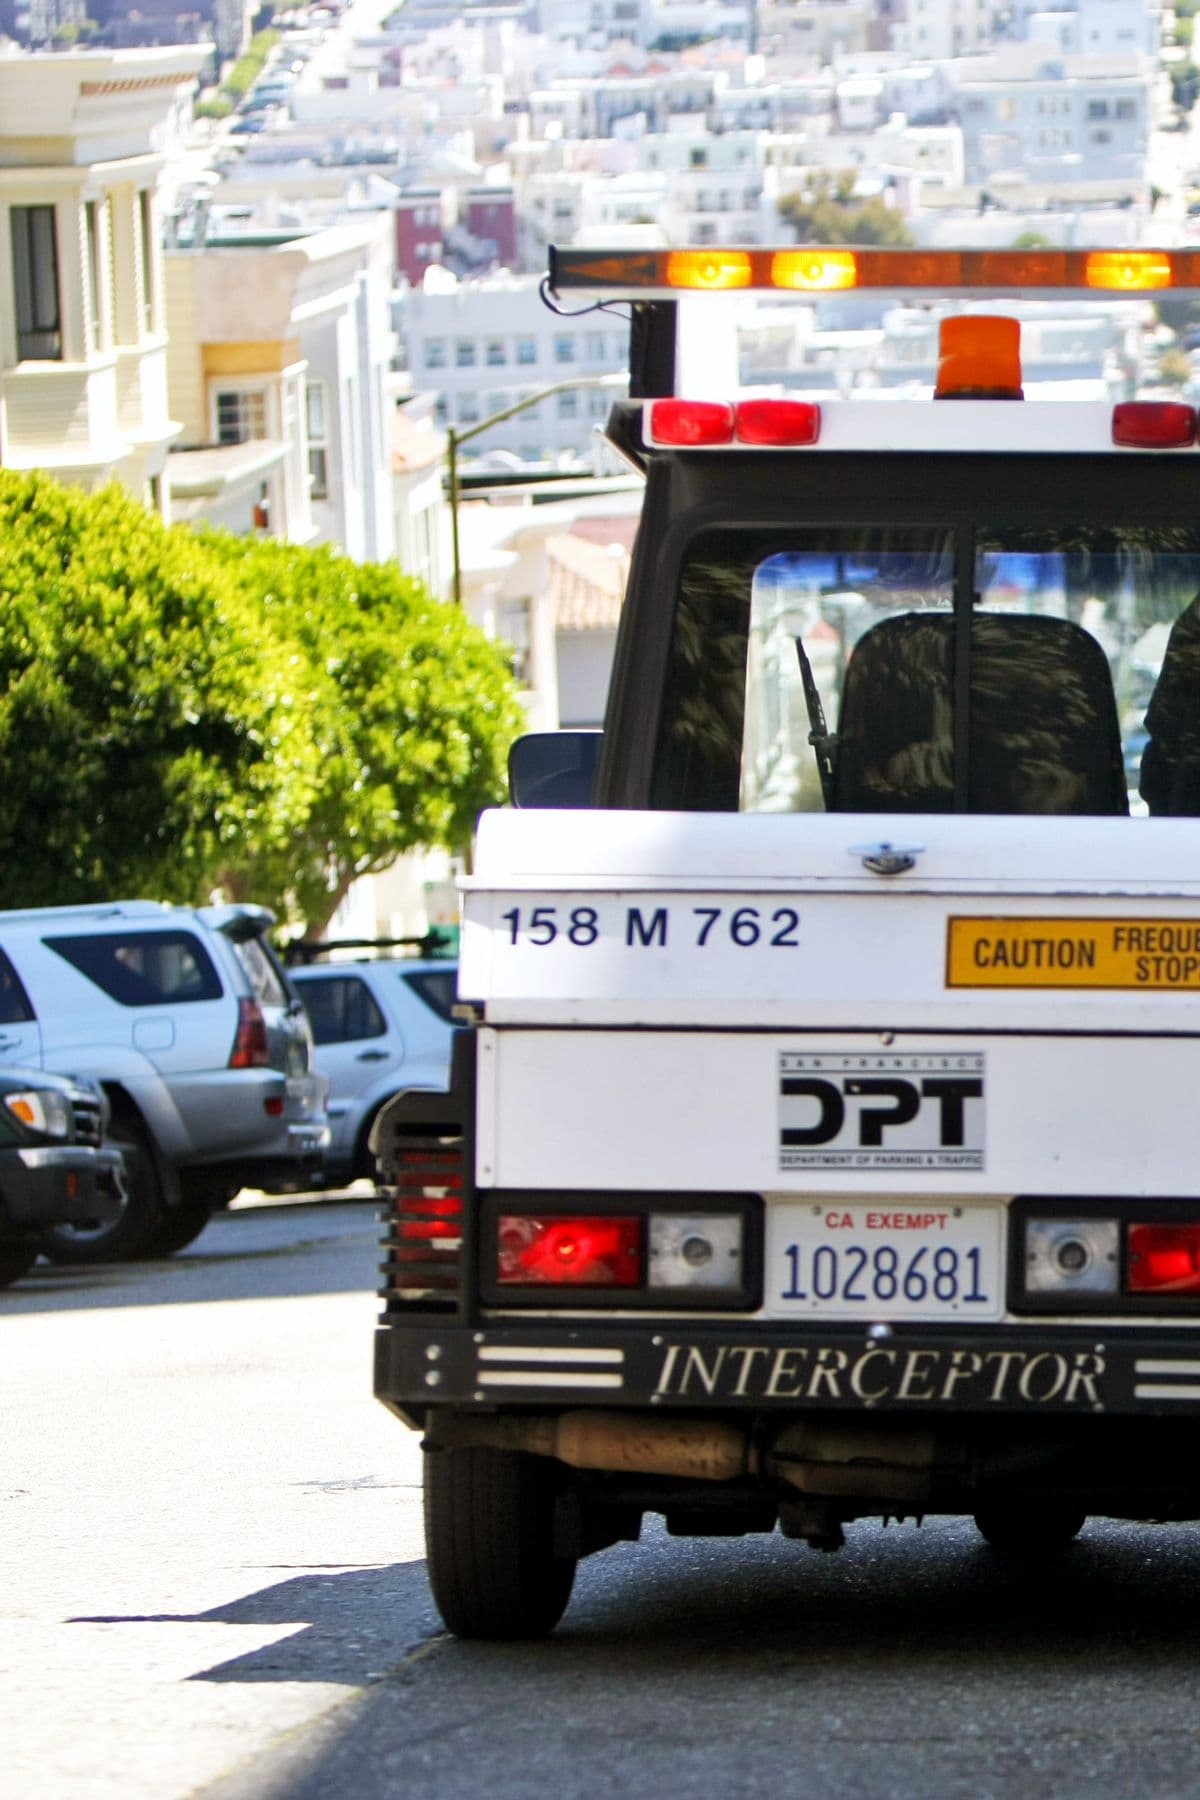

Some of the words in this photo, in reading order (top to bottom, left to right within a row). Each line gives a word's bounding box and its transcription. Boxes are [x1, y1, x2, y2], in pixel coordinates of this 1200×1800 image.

[501, 907, 599, 946] 158
[625, 908, 669, 946] M
[693, 908, 801, 946] 762
[974, 938, 1097, 968] CAUTION
[780, 1077, 984, 1146] DPT
[825, 1212, 854, 1229] CA
[865, 1212, 949, 1230] EXEMPT
[781, 1244, 988, 1303] 1028681
[653, 1344, 1105, 1402] INTERCEPTOR
